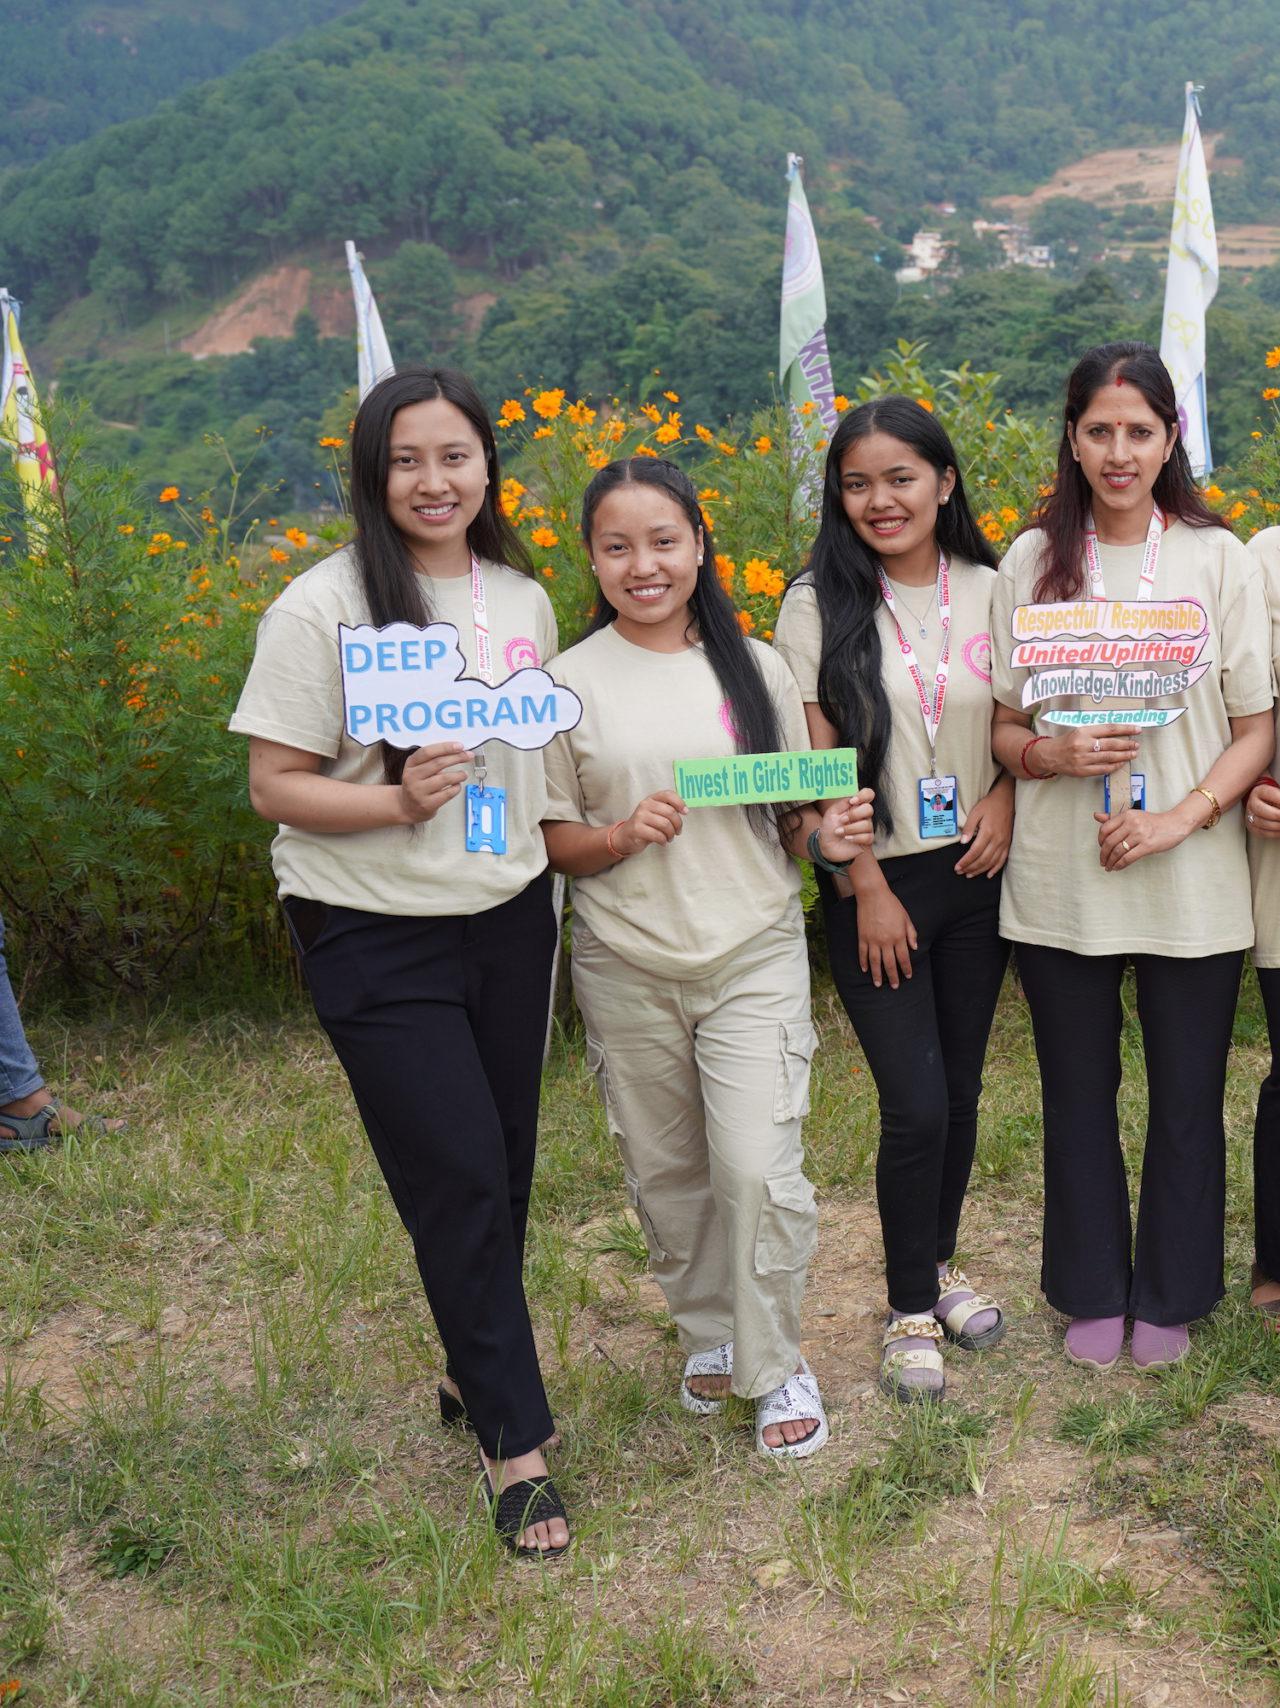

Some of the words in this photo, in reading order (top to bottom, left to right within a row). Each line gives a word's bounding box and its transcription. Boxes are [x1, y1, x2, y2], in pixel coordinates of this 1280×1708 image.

[1016, 603, 1098, 637] Respectful
[1110, 602, 1201, 635] Responsible
[345, 638, 447, 673] DEEP
[1018, 643, 1196, 666] United/Uplifting
[1031, 670, 1189, 701] Knowledge/Kindness
[349, 693, 557, 735] PROGRAM
[1051, 709, 1168, 724] Understanding
[679, 766, 730, 799] Invest
[733, 764, 748, 795] in
[752, 759, 793, 793] Girls'
